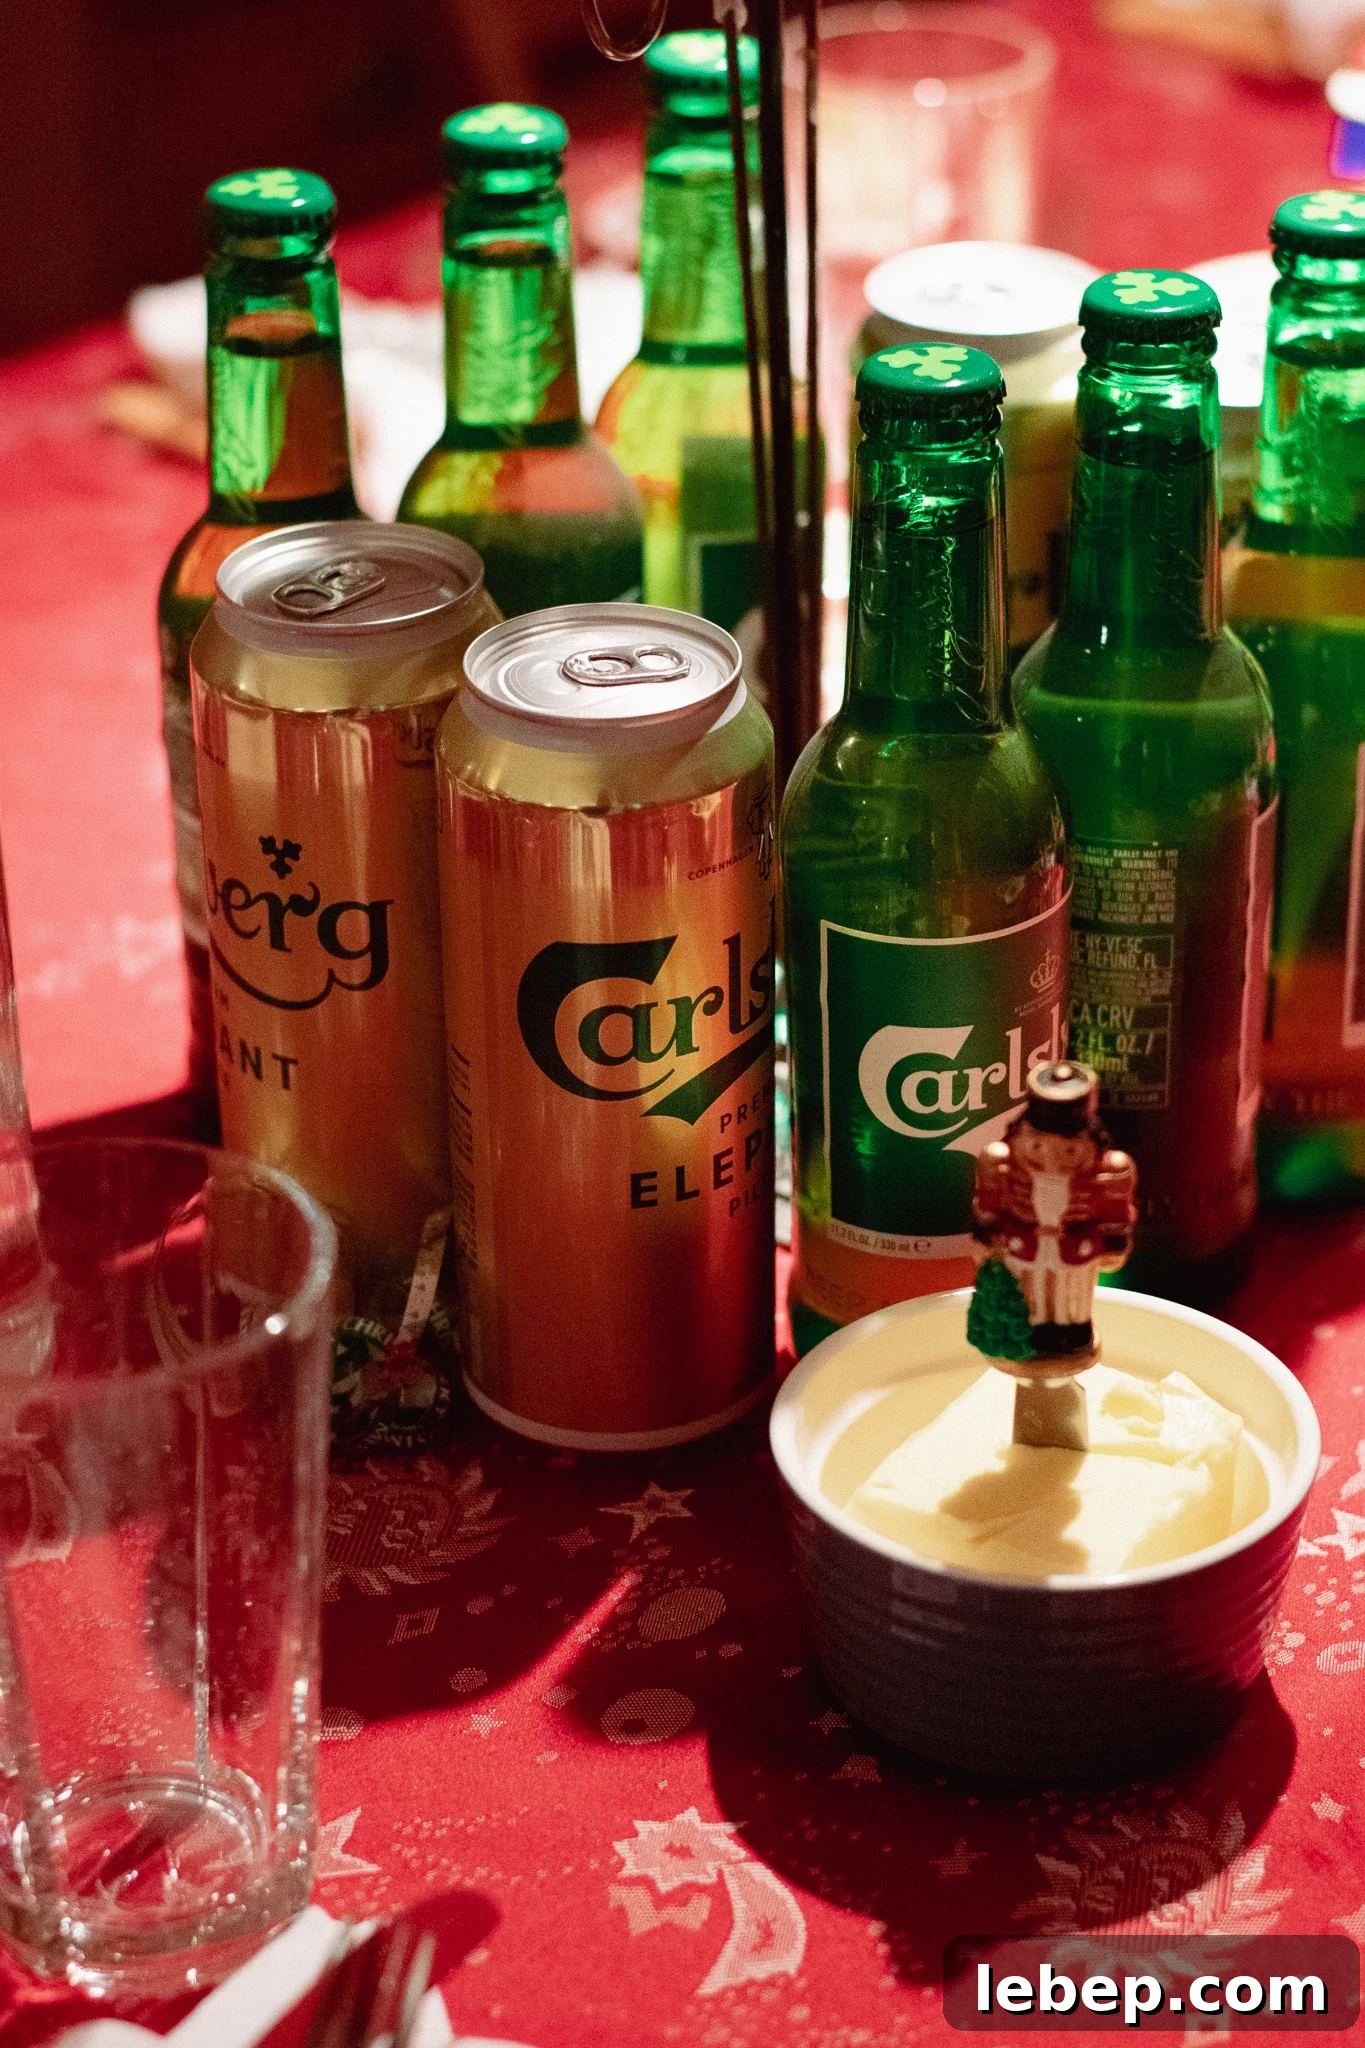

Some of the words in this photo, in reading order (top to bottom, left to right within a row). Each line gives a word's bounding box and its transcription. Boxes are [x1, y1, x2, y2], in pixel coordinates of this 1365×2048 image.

[1113, 849, 1140, 858] BARLEY
[1143, 850, 1162, 858] MALT
[1121, 859, 1160, 869] WARNING:
[1097, 1003, 1135, 1030] CRV
[631, 1125, 770, 1209] ELEP
